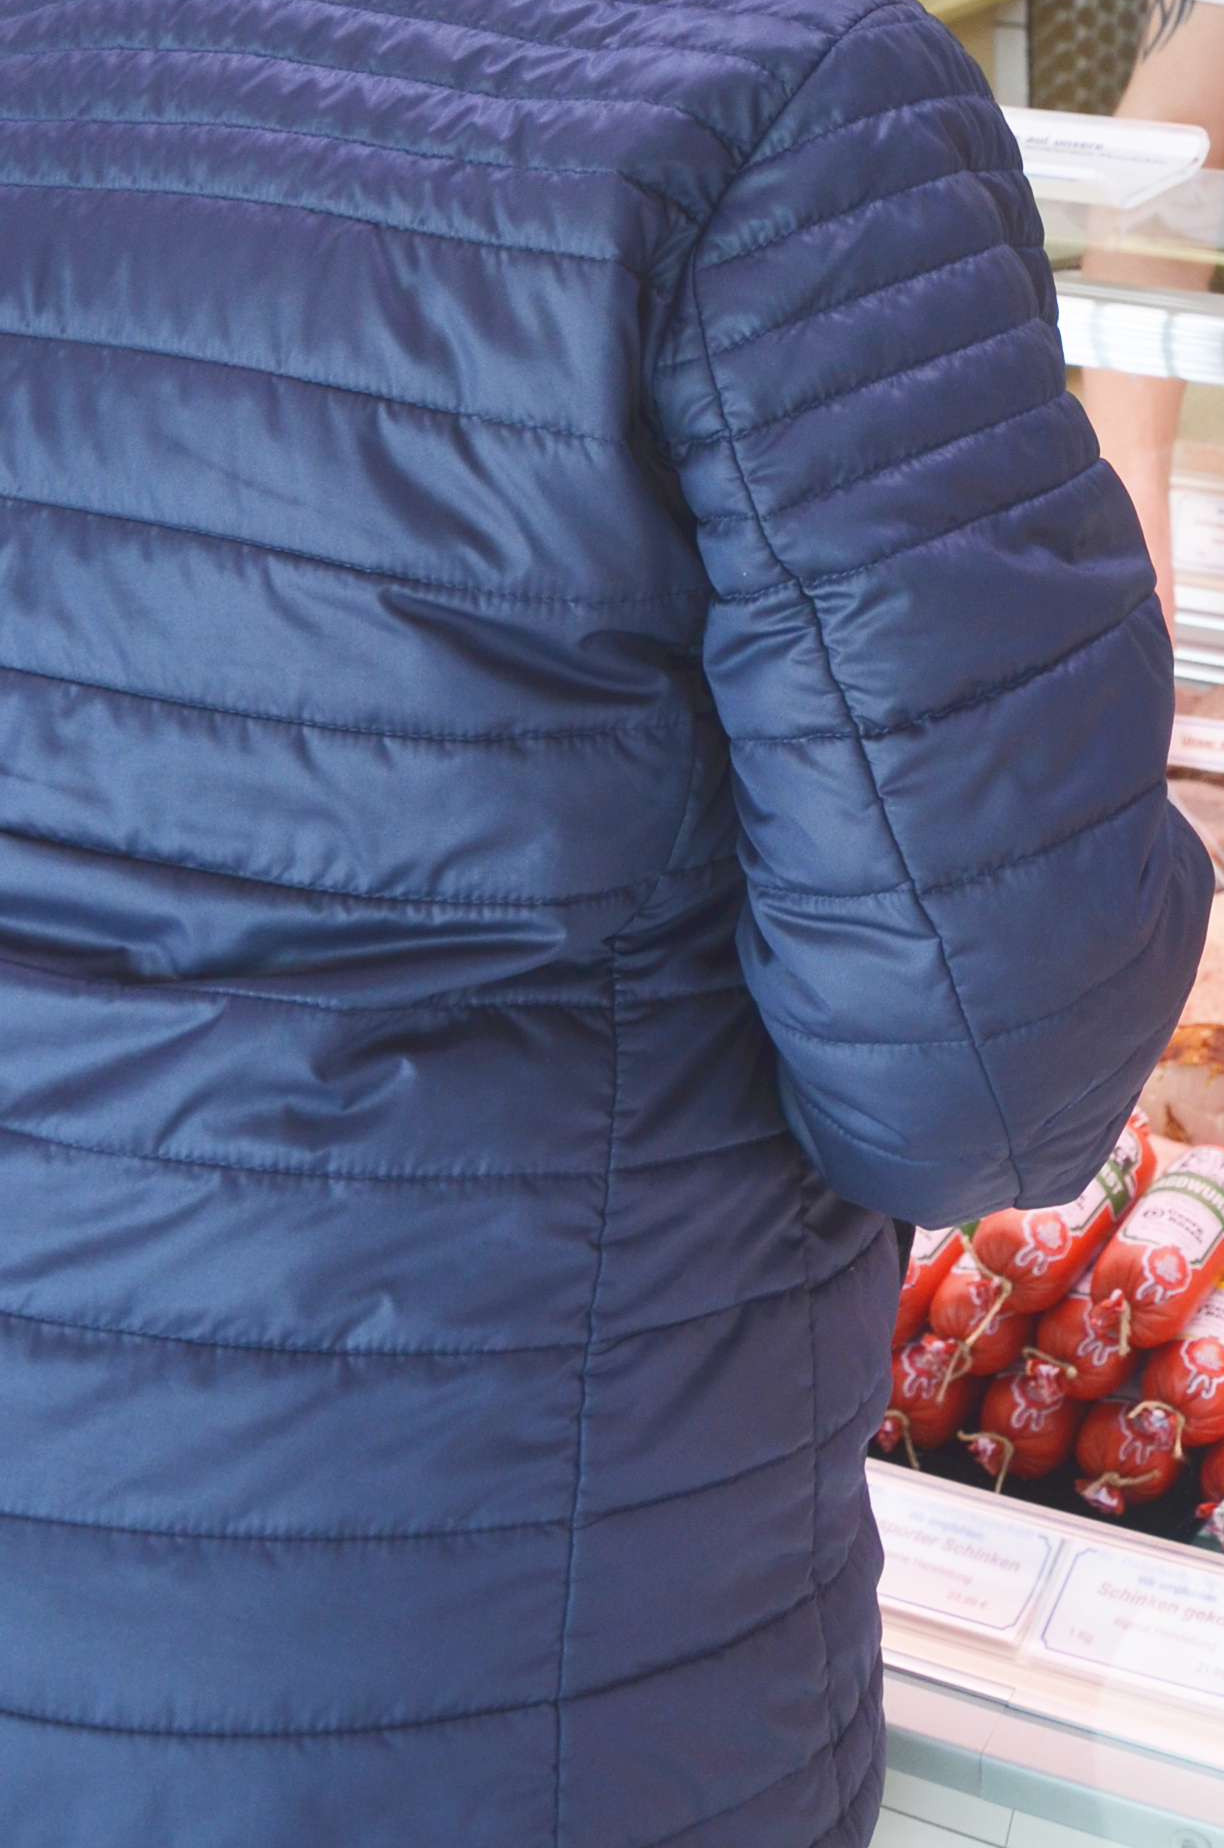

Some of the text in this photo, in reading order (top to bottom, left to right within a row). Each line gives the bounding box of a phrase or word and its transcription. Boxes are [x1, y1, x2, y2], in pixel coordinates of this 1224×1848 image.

[942, 1537, 1021, 1572] Schinken
[1097, 1582, 1179, 1615] Schinken
[1078, 1629, 1094, 1645] Kg
